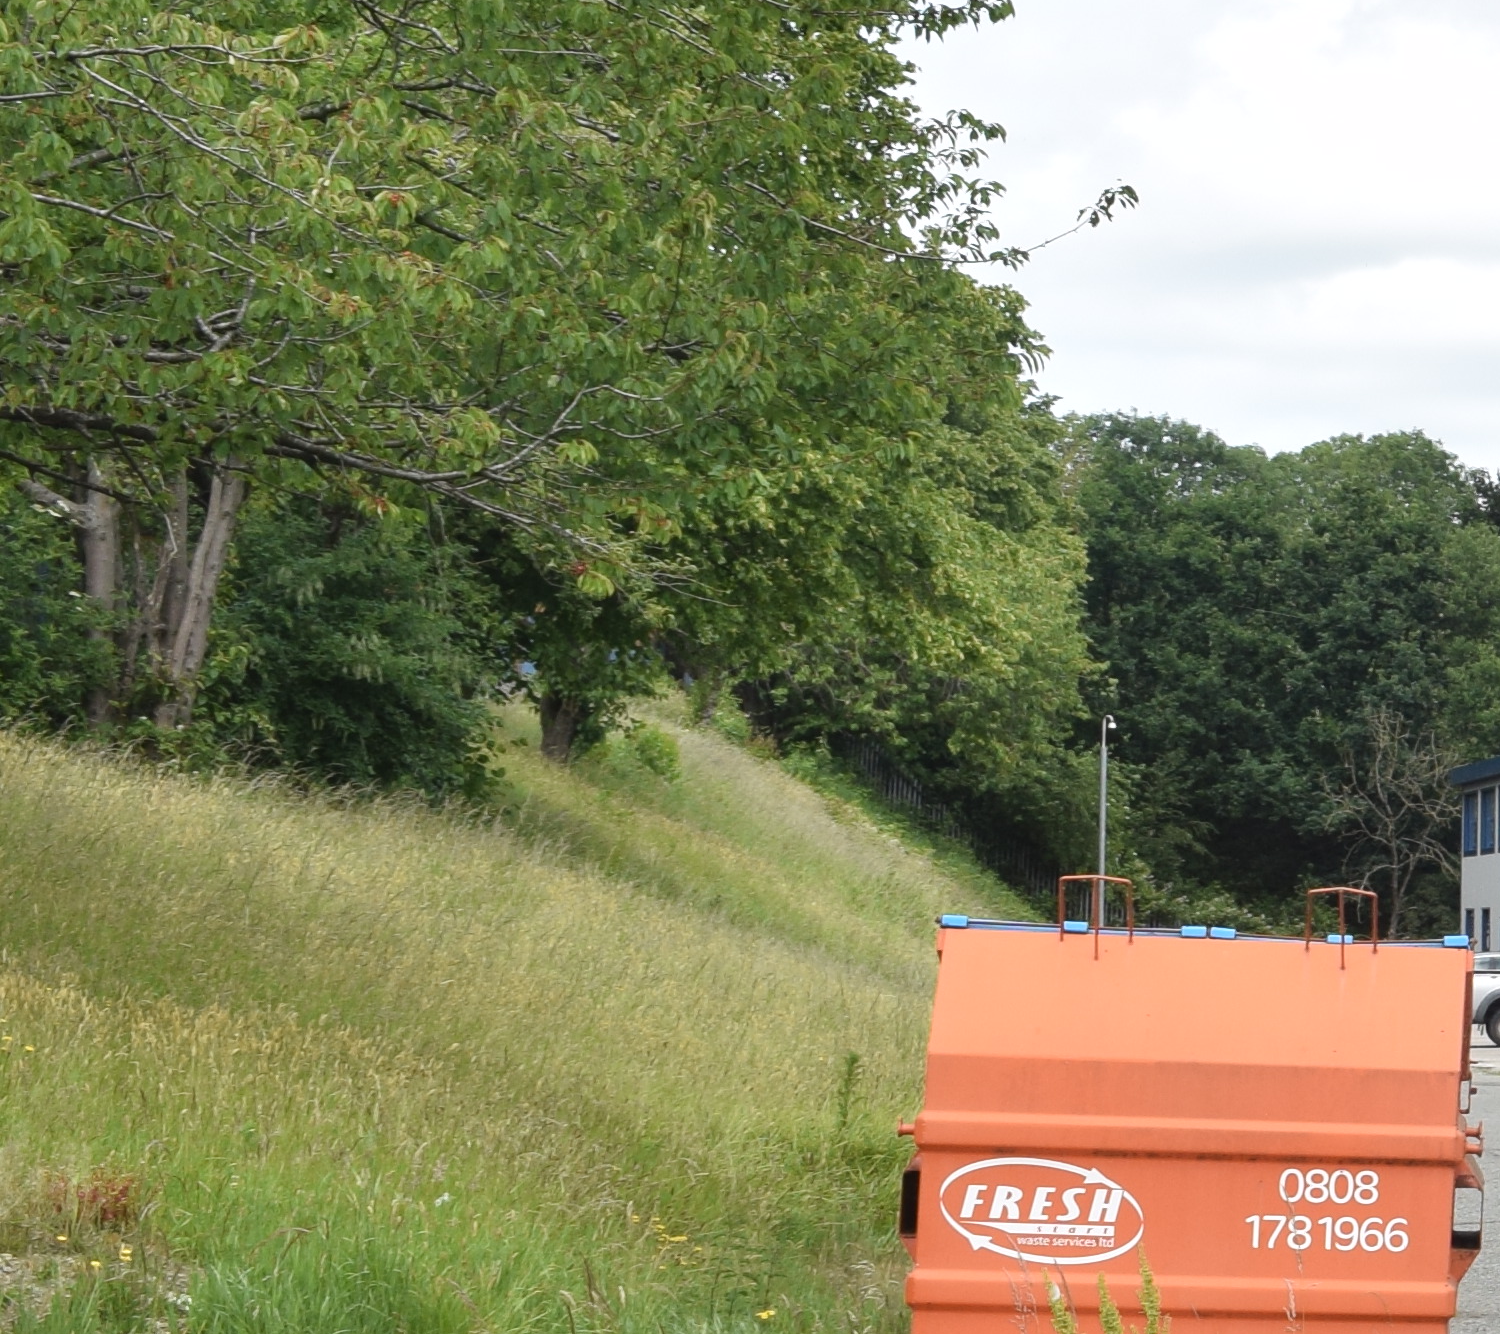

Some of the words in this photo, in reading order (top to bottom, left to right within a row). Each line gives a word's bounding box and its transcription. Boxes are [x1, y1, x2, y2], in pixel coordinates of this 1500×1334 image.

[959, 1184, 1125, 1223] FRESH
[1278, 1168, 1380, 1205] 0808
[1016, 1236, 1050, 1246] waste
[1052, 1237, 1096, 1248] services
[1098, 1237, 1115, 1248] ltd
[1036, 1225, 1109, 1235] start
[1245, 1214, 1313, 1250] 178
[1317, 1216, 1409, 1252] 1966
